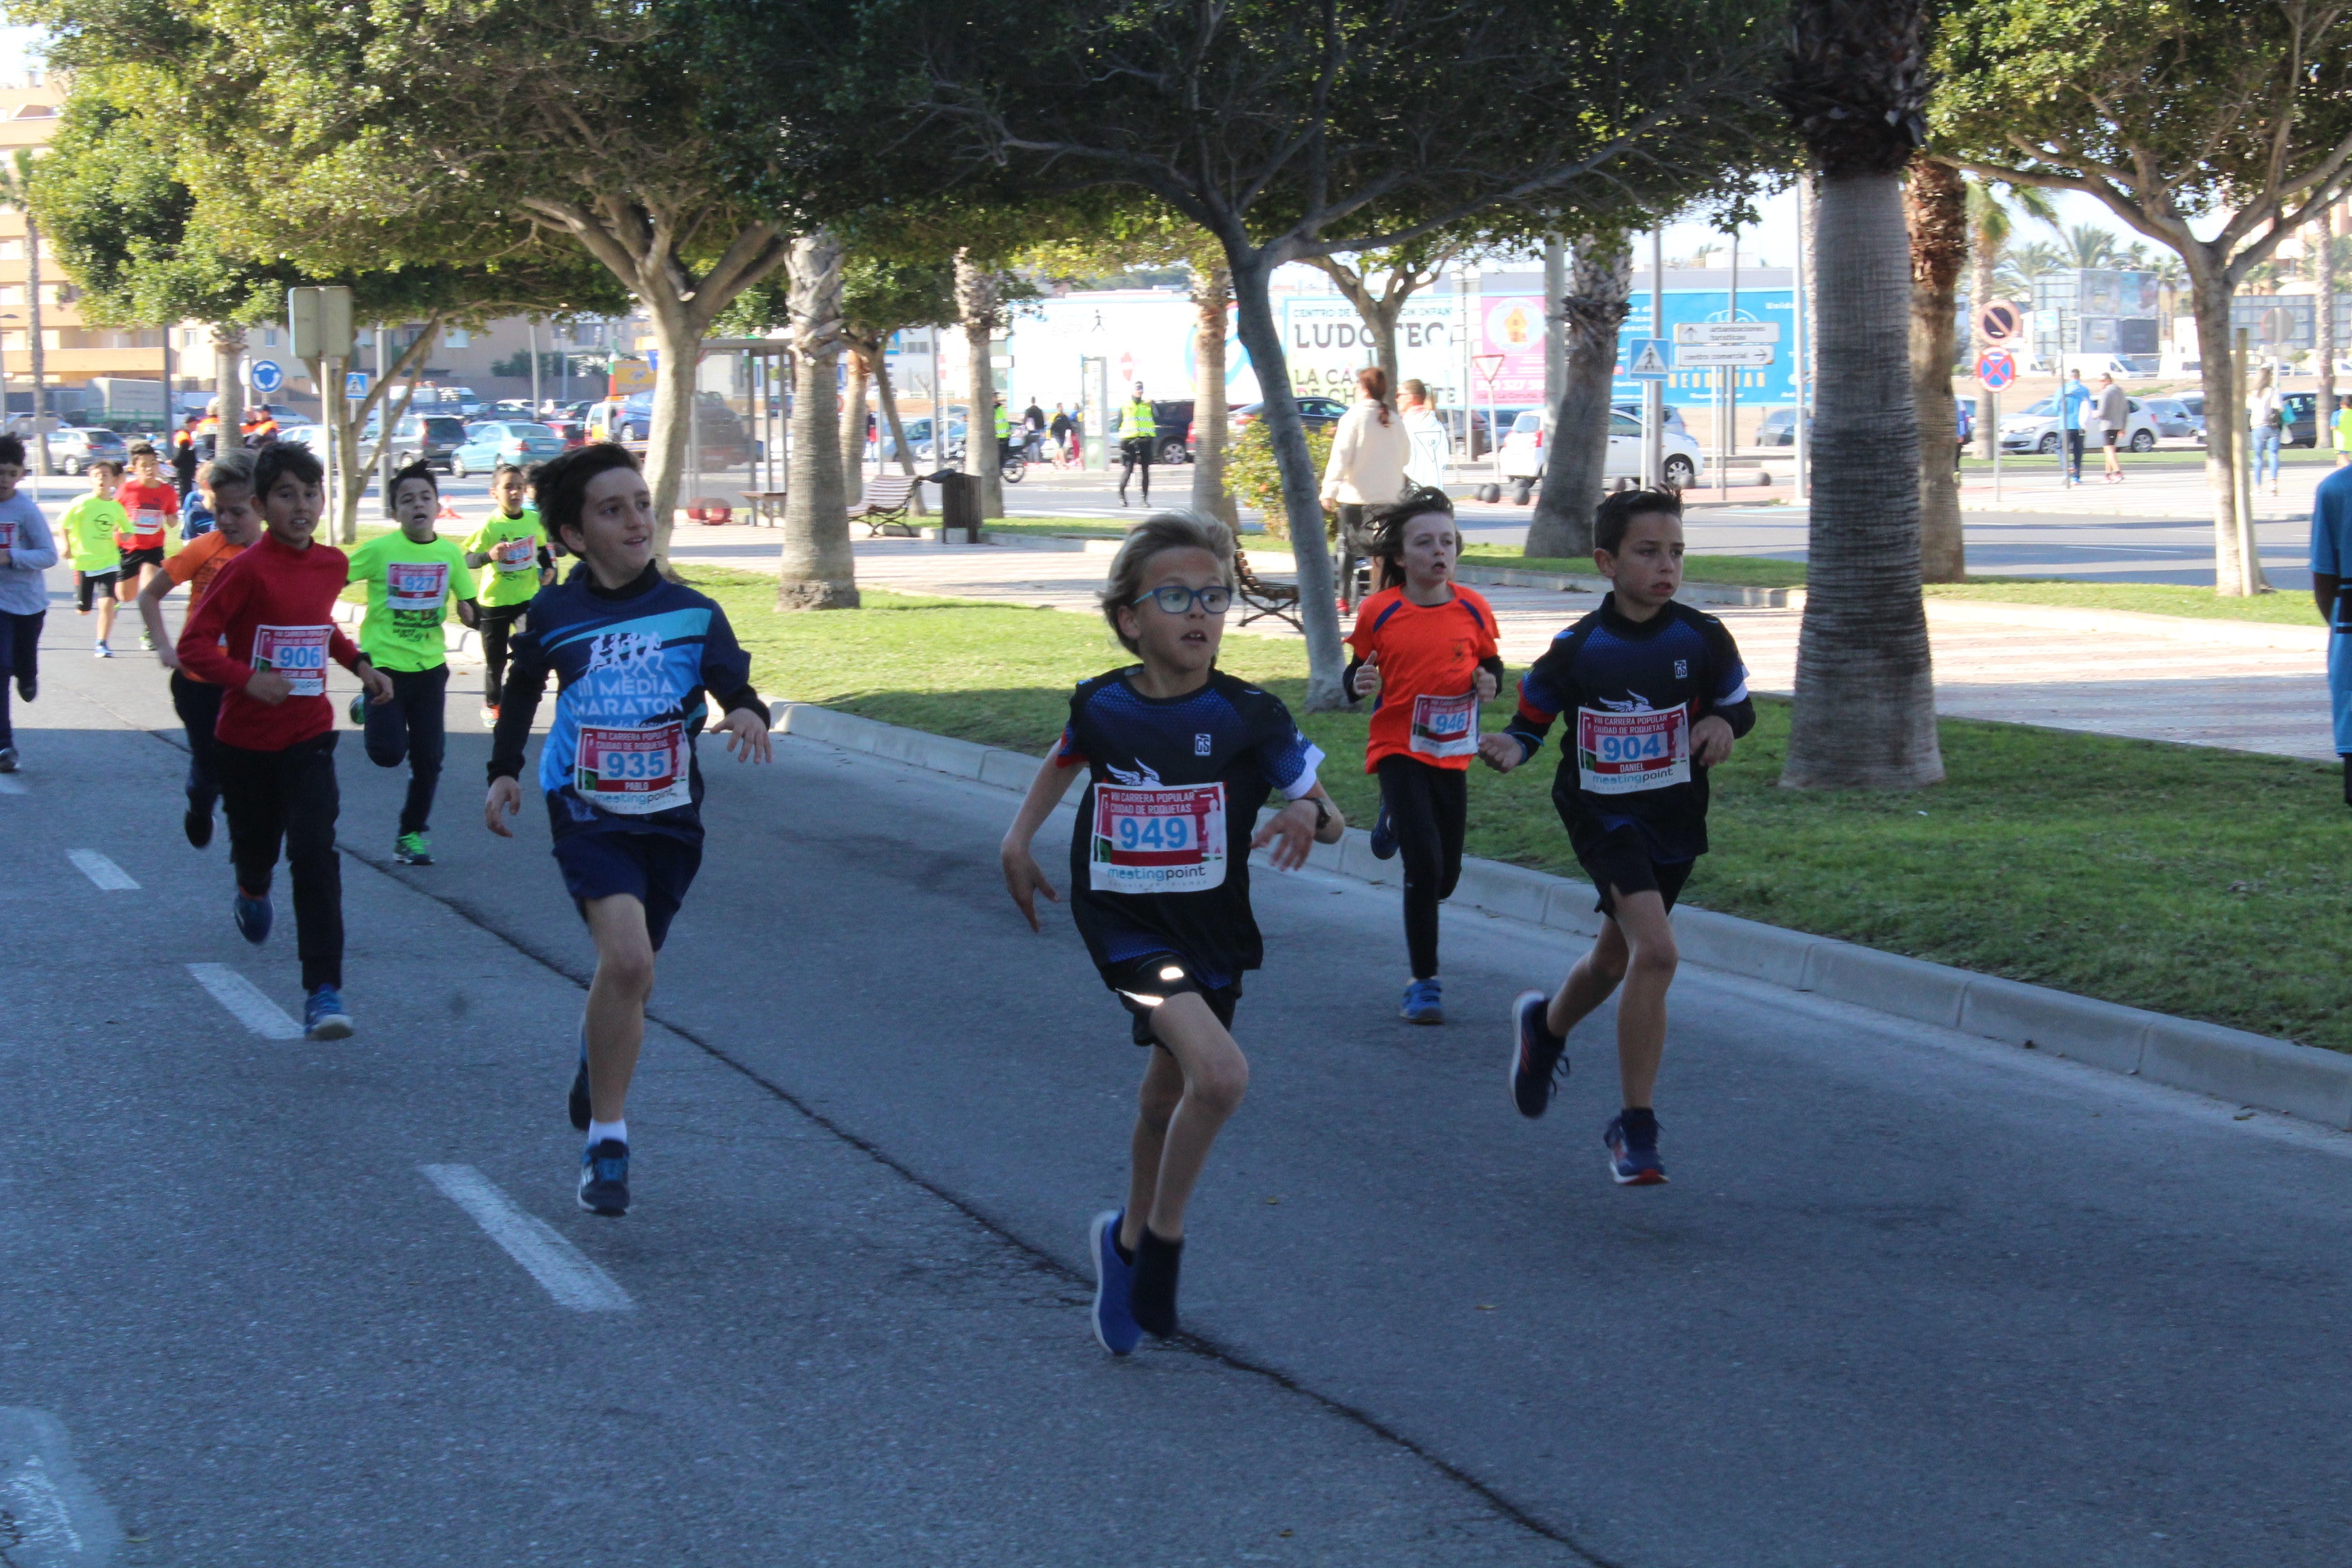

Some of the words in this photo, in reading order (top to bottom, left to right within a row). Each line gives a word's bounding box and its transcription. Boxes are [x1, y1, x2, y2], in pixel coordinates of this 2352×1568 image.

[404, 576, 435, 591] 927
[280, 646, 321, 668] 906
[599, 679, 675, 696] MEDIA
[1604, 716, 1636, 726] CARRERA
[1637, 714, 1668, 725] POPULAR
[1593, 725, 1618, 735] CIUDAD
[1618, 725, 1628, 734] DE
[1629, 723, 1665, 734] ROQUETAS
[1602, 733, 1662, 762] 904
[606, 751, 665, 778] 935
[1619, 762, 1645, 773] DANIEL
[1592, 767, 1674, 783] meetingpoint
[1121, 791, 1155, 803] CARRERA
[1156, 791, 1196, 802] POPULAR
[1135, 804, 1146, 815] DE
[1147, 802, 1192, 815] ROQUETAS
[1119, 817, 1188, 850] 949
[1107, 864, 1207, 881] meetingpoint
